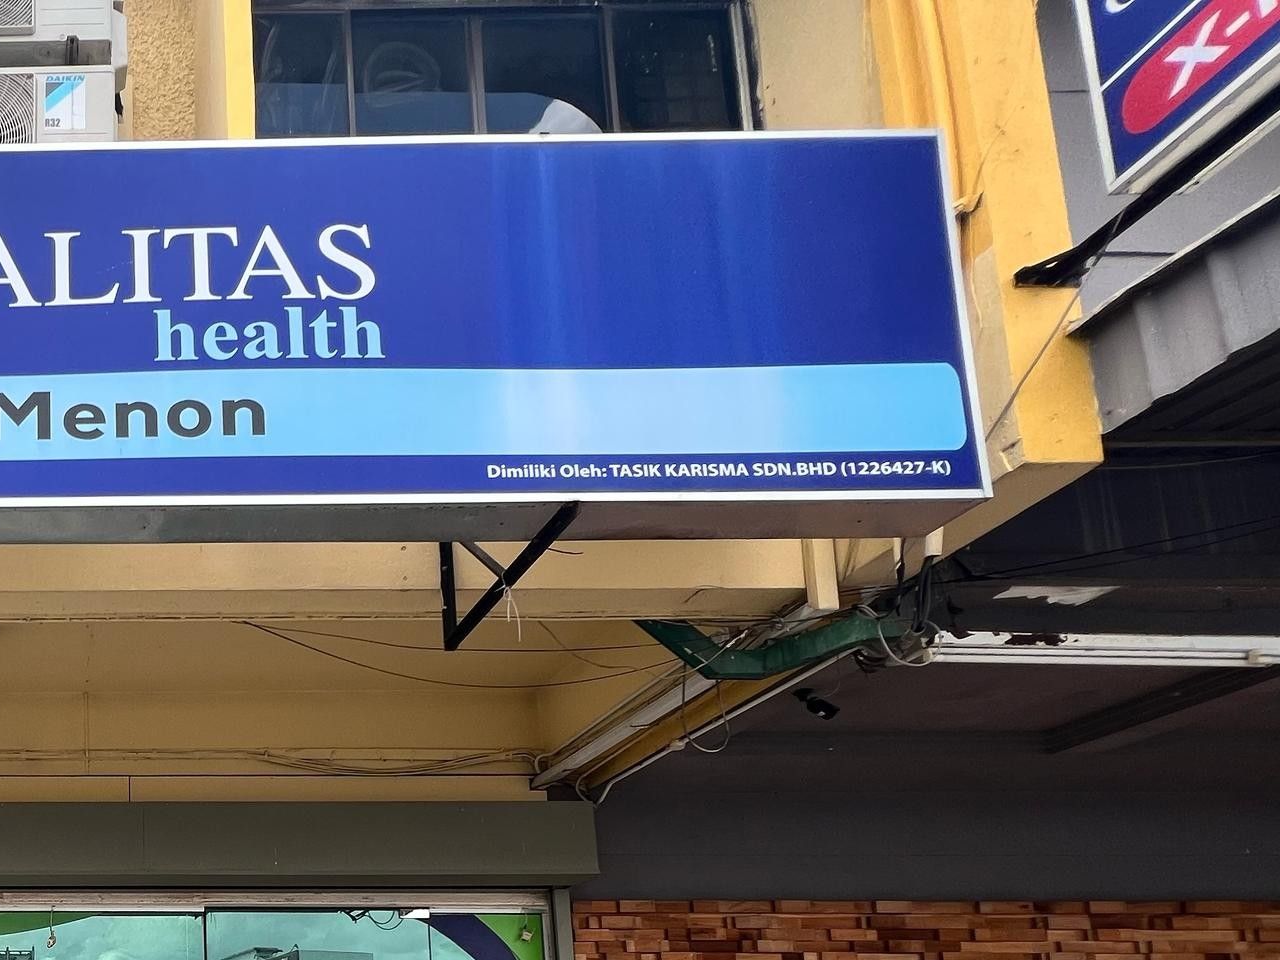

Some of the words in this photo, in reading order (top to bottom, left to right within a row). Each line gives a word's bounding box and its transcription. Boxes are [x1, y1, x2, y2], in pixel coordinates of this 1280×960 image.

[45, 118, 61, 128] R32
[154, 308, 385, 362] health
[487, 464, 556, 479] Dimiliki
[560, 464, 607, 479] Oleh:
[609, 464, 661, 478] TASIK
[665, 463, 748, 477] KARISMA
[752, 462, 837, 477] SDN.BHD
[840, 461, 951, 477] (1226427-K)
